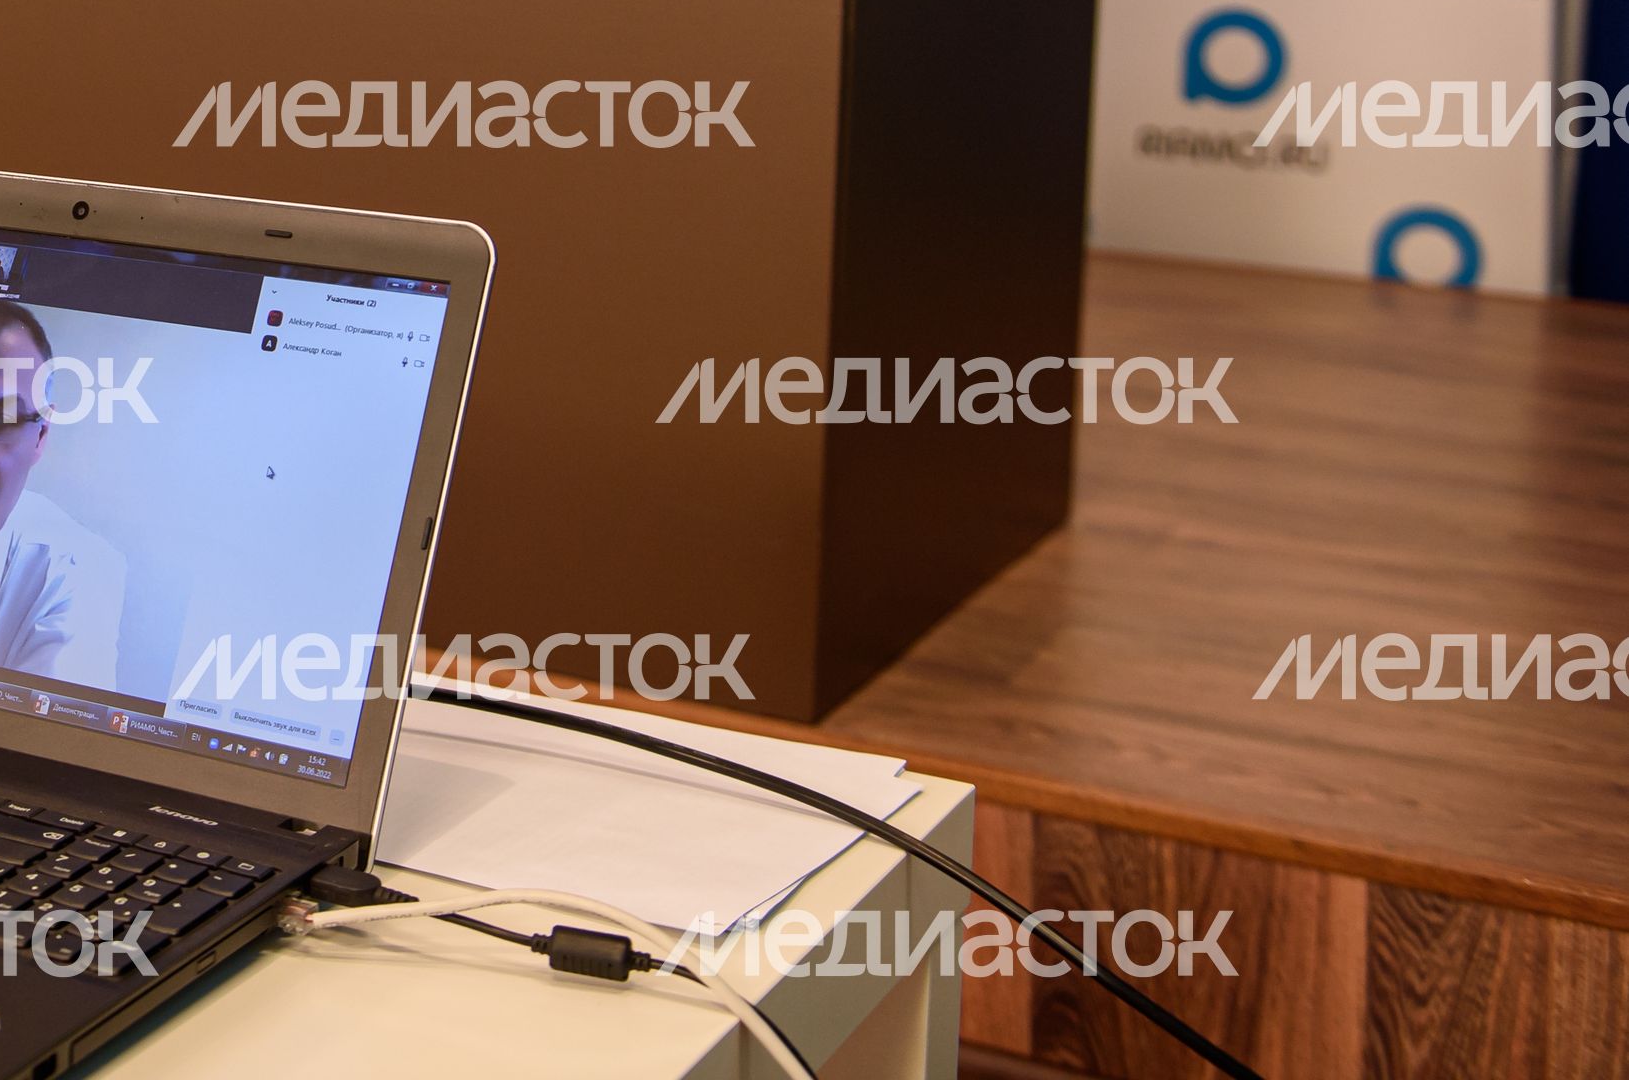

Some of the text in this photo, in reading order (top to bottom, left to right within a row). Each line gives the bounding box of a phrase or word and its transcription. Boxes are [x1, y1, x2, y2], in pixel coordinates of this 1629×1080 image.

[326, 294, 364, 306] Участники
[289, 318, 314, 328] Aleksey
[283, 343, 342, 357] Александр Коган
[179, 700, 218, 715] Пригласить
[234, 712, 272, 727] Выключить
[273, 722, 287, 730] звук
[288, 725, 301, 734] для
[191, 733, 201, 742] EN
[148, 806, 219, 826] lenovo
